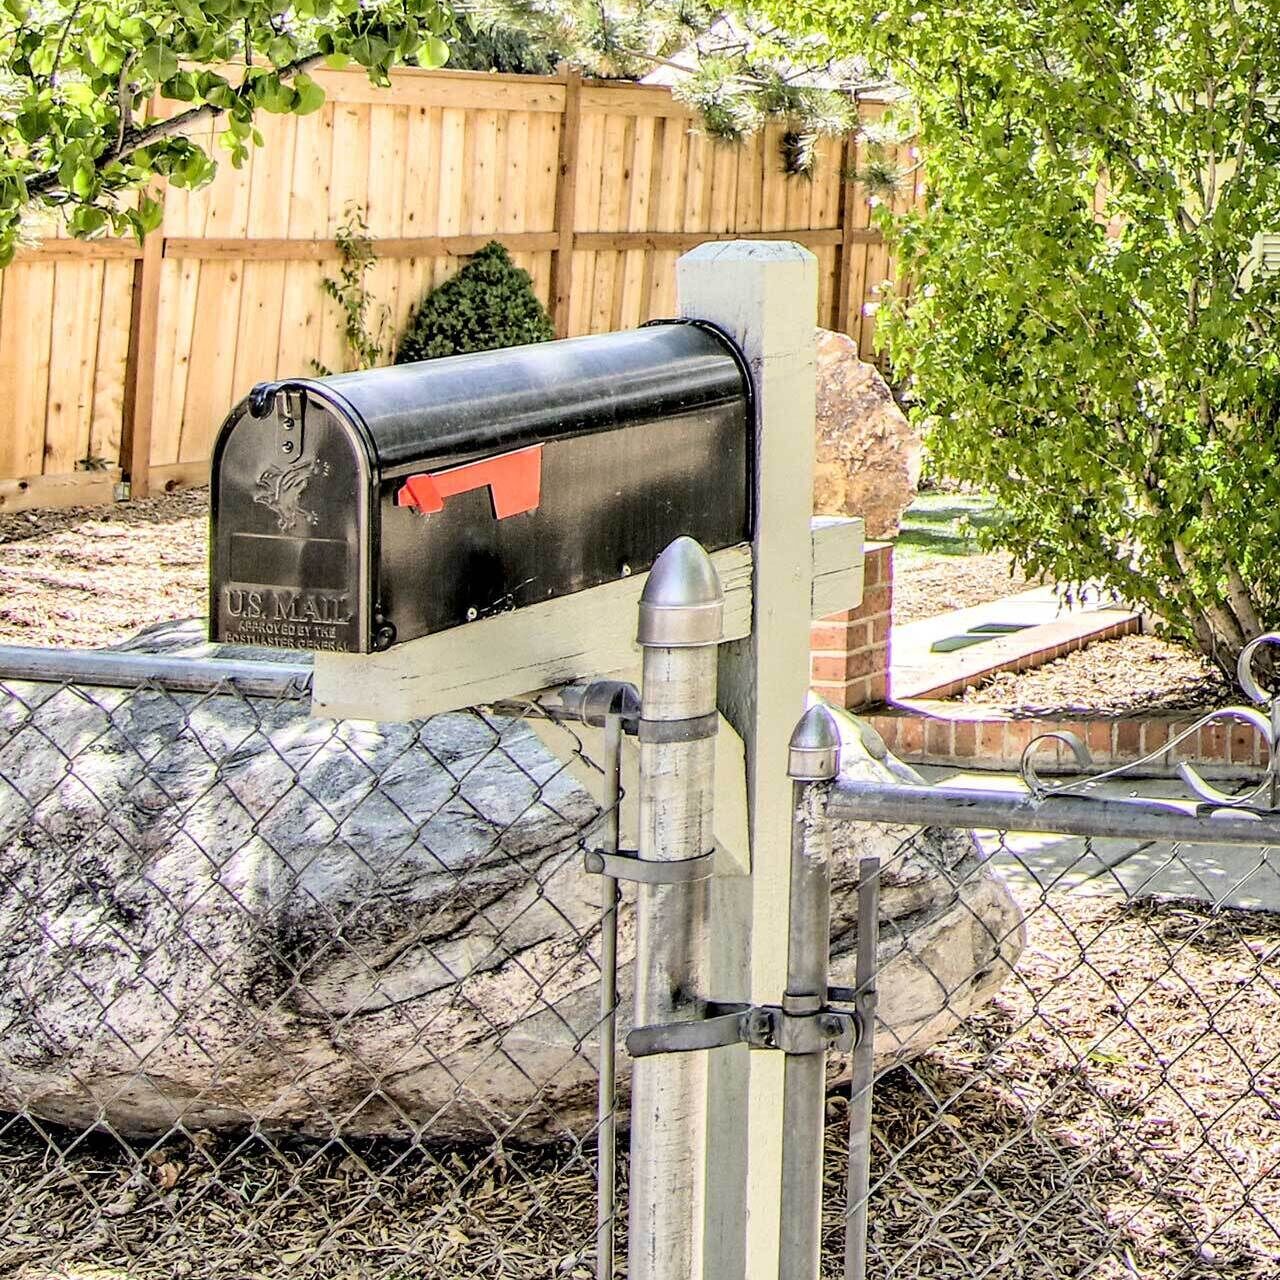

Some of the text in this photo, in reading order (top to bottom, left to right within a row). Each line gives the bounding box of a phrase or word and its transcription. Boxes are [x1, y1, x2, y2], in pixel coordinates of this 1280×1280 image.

[224, 589, 353, 625] U.S. MAIL
[238, 620, 337, 639] APPROVED BY THE
[225, 631, 350, 652] POSTMASTER GENERAL
